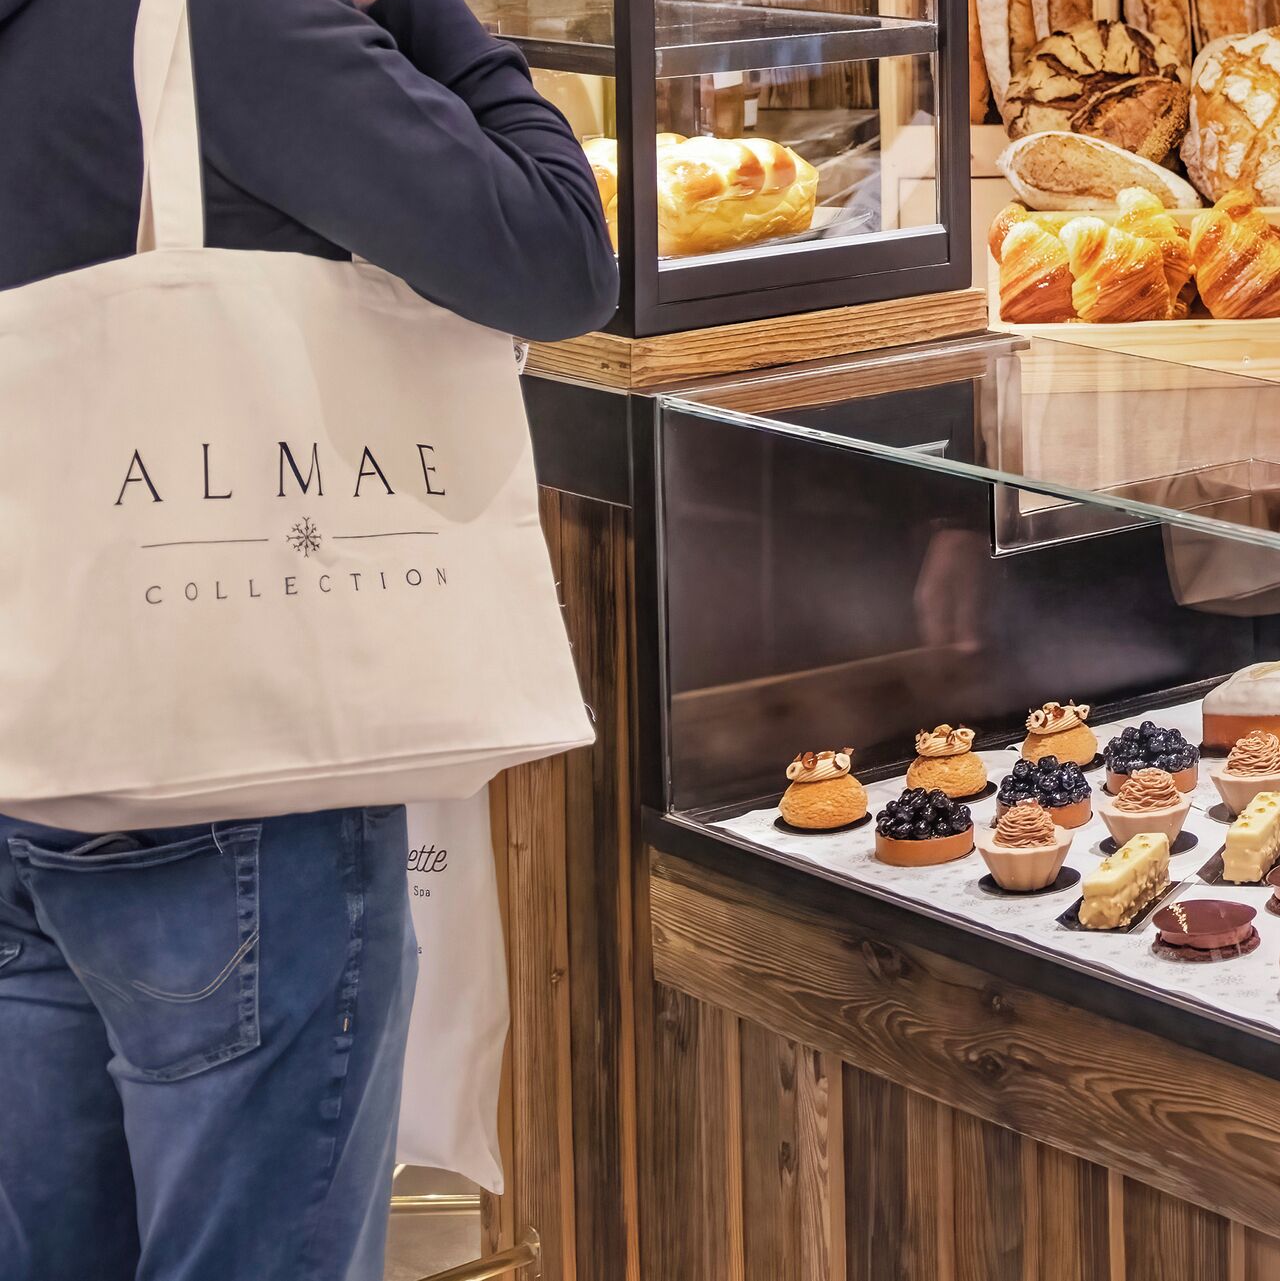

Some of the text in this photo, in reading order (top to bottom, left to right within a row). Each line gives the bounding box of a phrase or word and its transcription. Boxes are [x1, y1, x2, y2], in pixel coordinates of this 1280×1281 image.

[113, 441, 446, 506] ALMAE
[145, 567, 448, 605] COLLECTION
[413, 885, 431, 897] Spa
